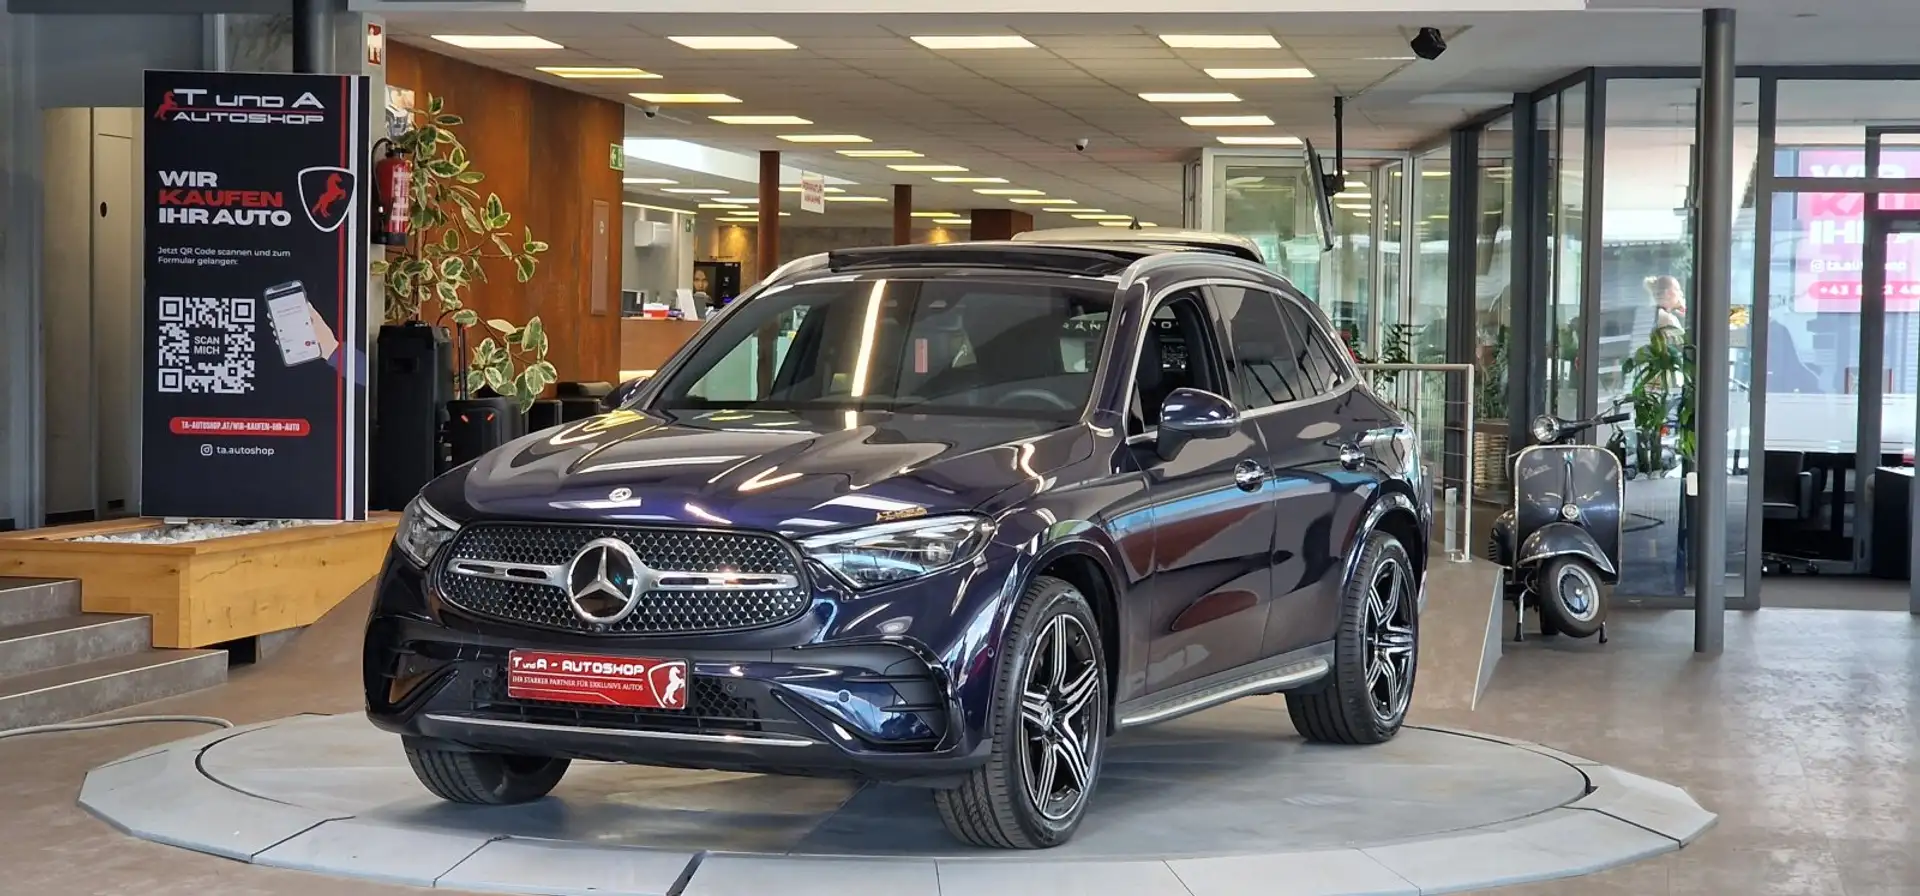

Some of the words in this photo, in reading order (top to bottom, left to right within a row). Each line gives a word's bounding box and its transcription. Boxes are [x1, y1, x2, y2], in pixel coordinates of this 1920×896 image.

[173, 88, 207, 105] T
[291, 92, 324, 109] A
[172, 111, 324, 124] AUTOSHOP
[158, 170, 218, 187] WIR
[159, 190, 283, 207] KAUFEN
[159, 208, 208, 224] IHR
[212, 210, 292, 226] AUTO
[157, 246, 178, 255] Jetzt
[180, 247, 193, 256] QR
[194, 247, 216, 256] Code
[254, 249, 271, 257] und
[158, 256, 196, 264] Formular
[194, 336, 220, 345] SCAN
[194, 346, 220, 355] MICH
[181, 420, 300, 432] TA-AUTOSHOP.AT/WIR-KAUFEN-IHR-AUTO
[216, 446, 275, 456] ta.autoshop
[512, 656, 523, 668] T
[536, 658, 547, 670] A
[561, 660, 645, 676] AUTOSHOP
[524, 676, 549, 685] STARKER
[549, 678, 576, 688] PARTNER
[576, 679, 589, 688] FÜR
[589, 681, 621, 690] EXKLUSIVE
[621, 683, 644, 691] AUTOS
